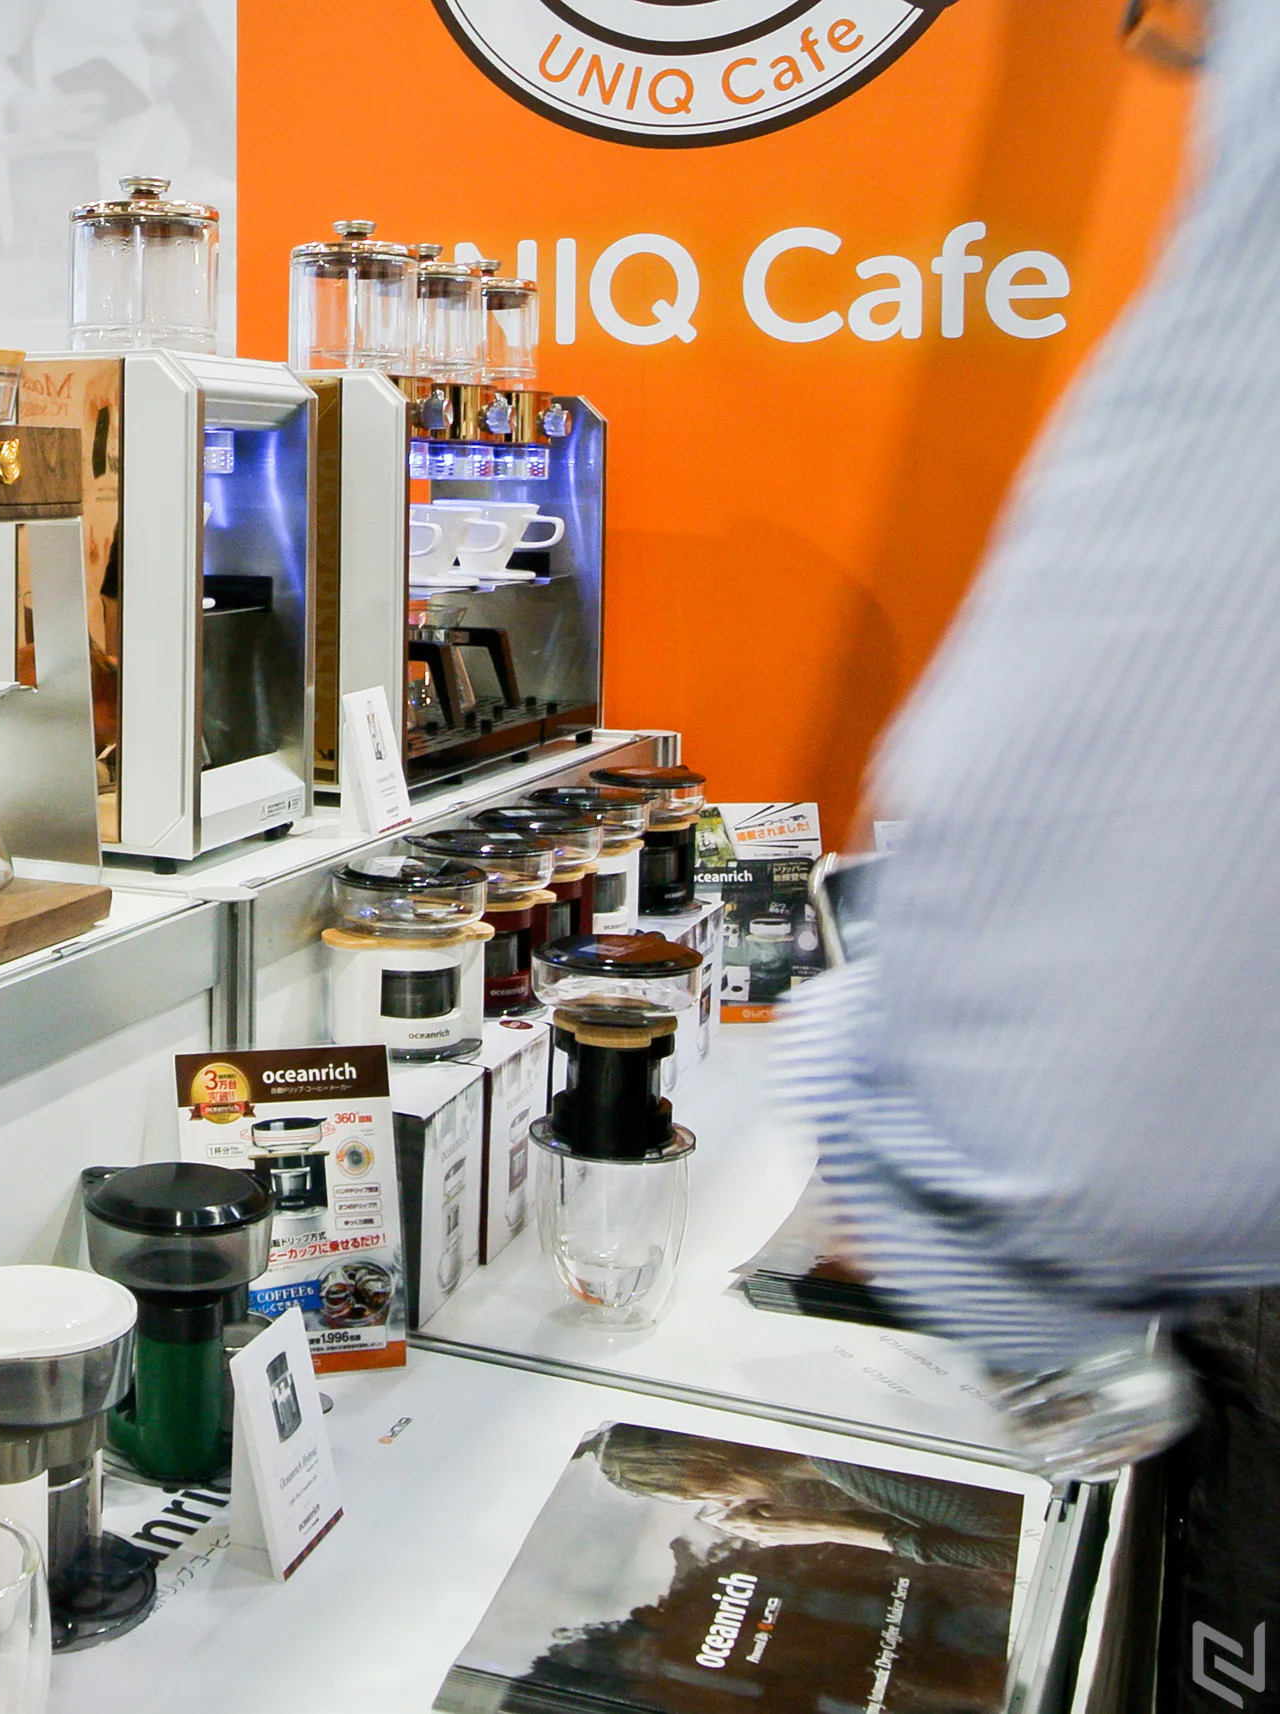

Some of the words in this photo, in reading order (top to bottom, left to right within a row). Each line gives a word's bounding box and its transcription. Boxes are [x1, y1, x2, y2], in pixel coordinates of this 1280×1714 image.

[537, 33, 696, 115] UNIQ
[721, 17, 865, 105] Cafe
[455, 233, 700, 345] NIQ
[743, 221, 1070, 344] Cafe
[408, 1028, 450, 1040] oceanrich
[262, 1062, 357, 1085] oceanrich
[891, 1576, 911, 1600] Series
[695, 1572, 759, 1669] oceanrich
[885, 1599, 905, 1624] Maker
[879, 1624, 904, 1651] Coffee
[875, 1650, 900, 1670] Drip
